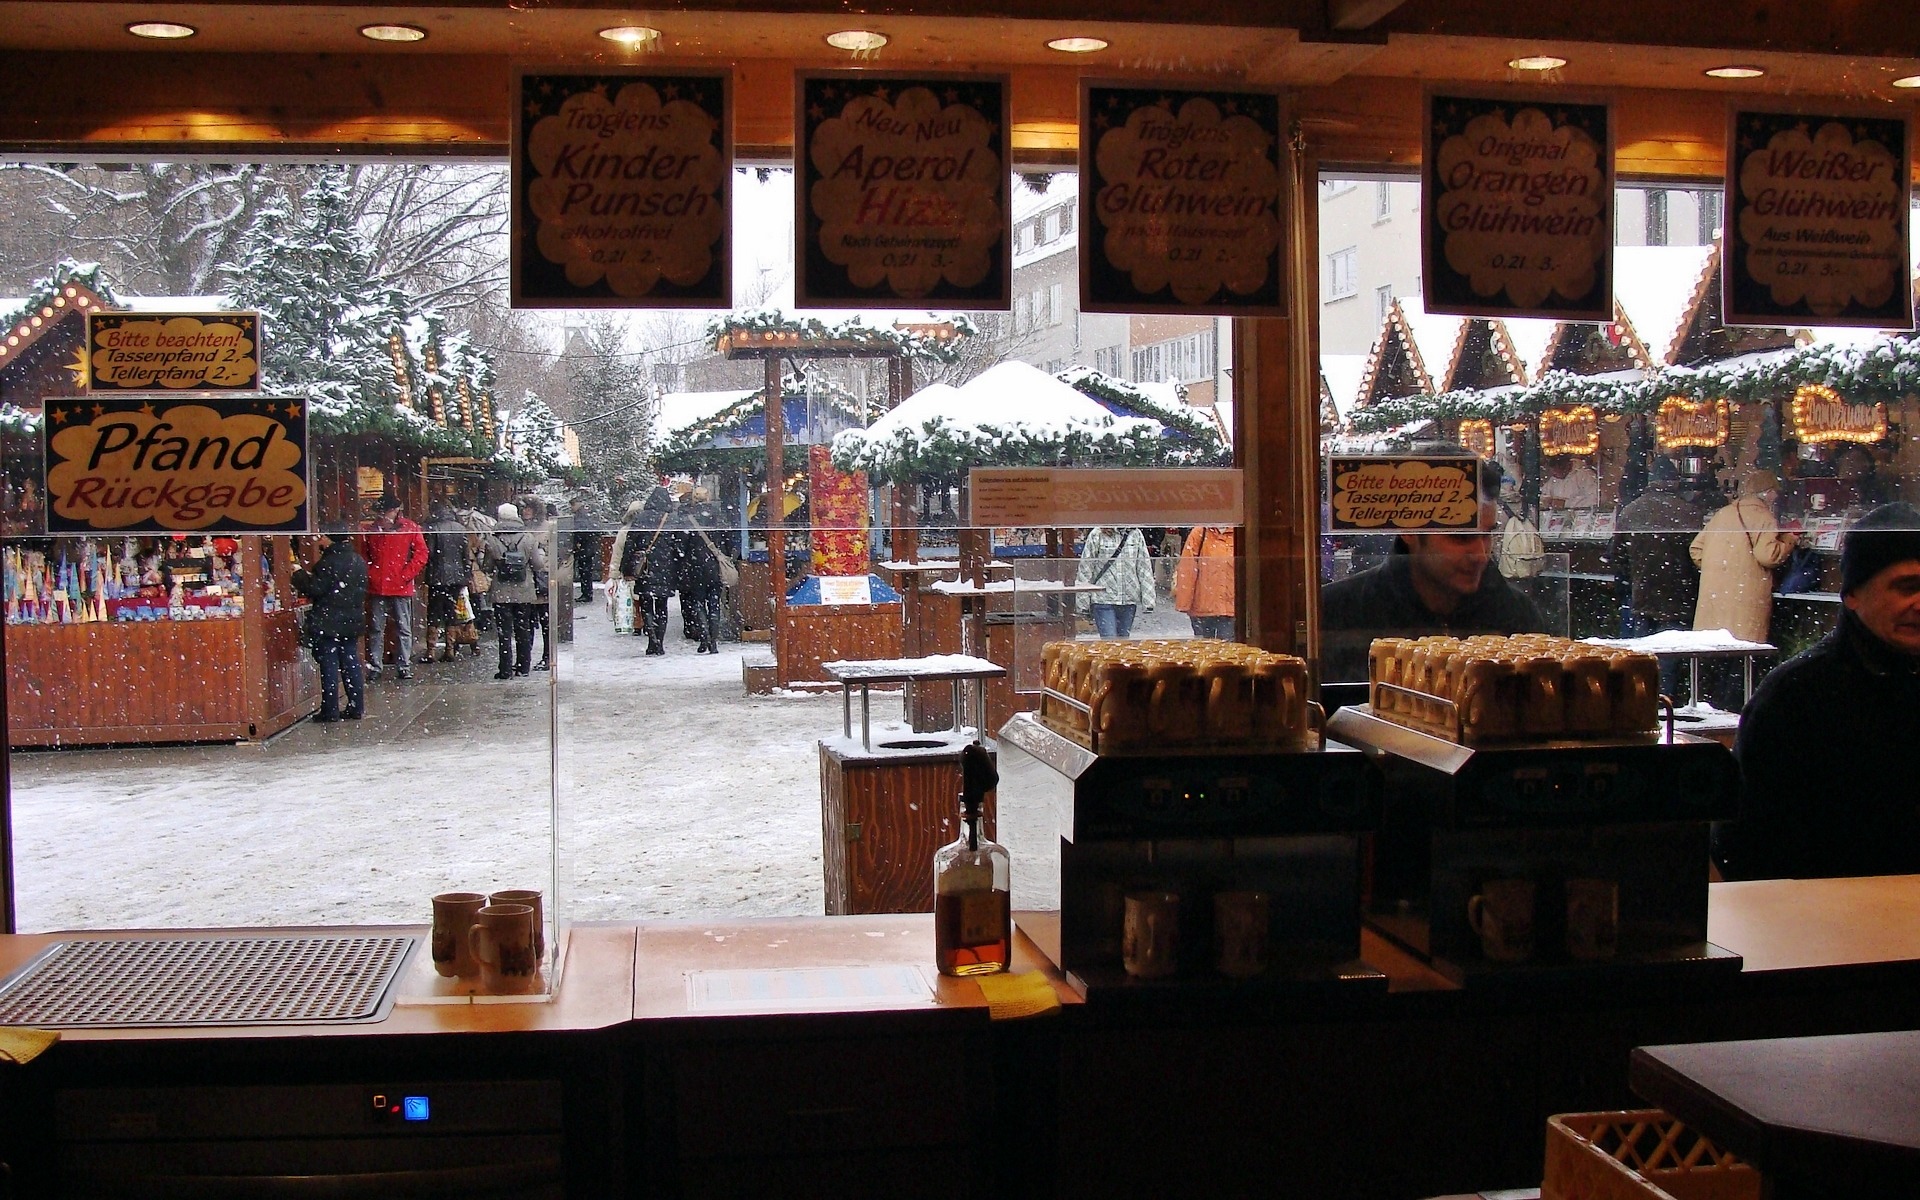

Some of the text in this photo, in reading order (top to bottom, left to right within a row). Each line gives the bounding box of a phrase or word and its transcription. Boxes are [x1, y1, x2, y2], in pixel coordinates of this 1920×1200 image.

[856, 106, 961, 143] Neu Neu
[552, 142, 699, 180] Kinder
[1136, 148, 1238, 181] Roter
[1479, 135, 1570, 165] Original
[1767, 150, 1884, 182] Weißer
[832, 143, 975, 191] Aperol
[1449, 161, 1589, 205] Orangen
[560, 182, 708, 216] Punsch
[1102, 182, 1268, 217] Glühwein
[1753, 188, 1897, 220] Glühwein
[1446, 202, 1596, 236] Glühwein
[1760, 226, 1790, 243] Aus
[107, 331, 242, 347] Bitte beachten!
[106, 349, 219, 365] Tassenpfand
[110, 366, 238, 383] Tellerpfand 2,-
[87, 422, 278, 471] Pfand
[1346, 474, 1465, 489] Bitte beachten!
[66, 476, 294, 521] Rückgabe
[1346, 491, 1444, 507] Tassenpfand
[1349, 507, 1461, 524] Tellerpfand 2,-
